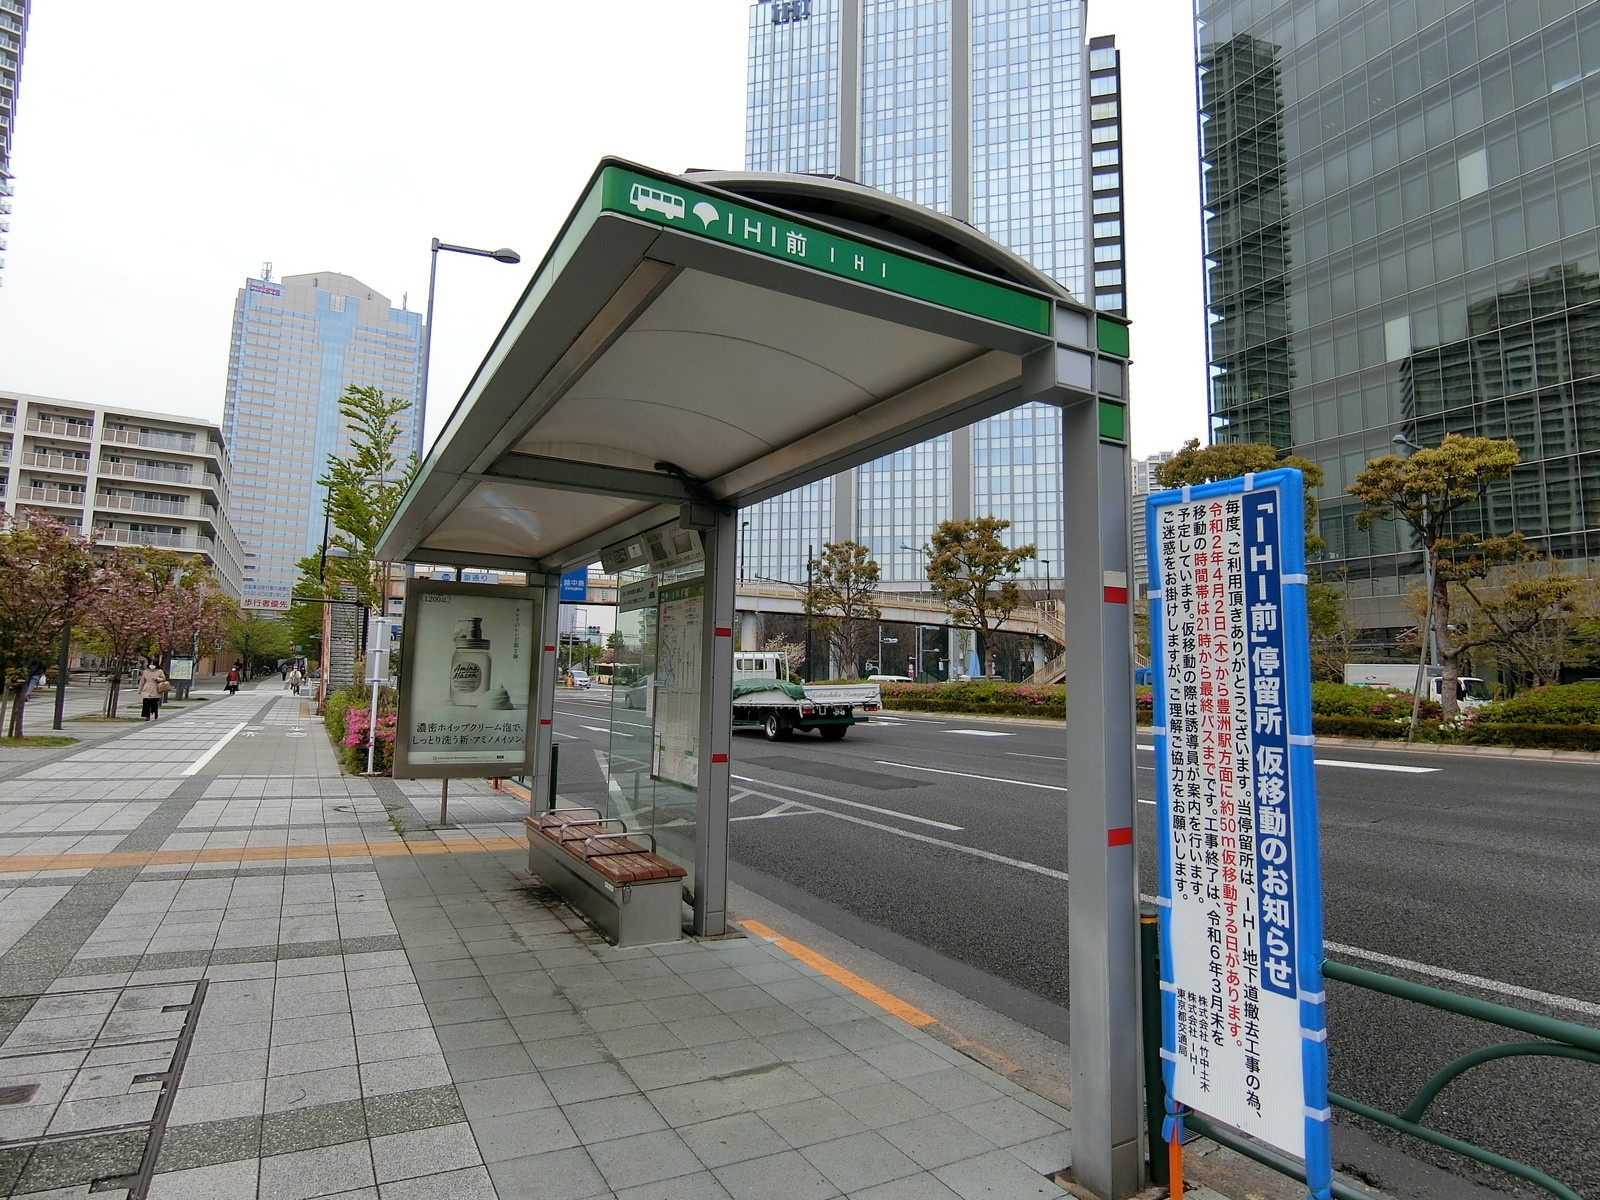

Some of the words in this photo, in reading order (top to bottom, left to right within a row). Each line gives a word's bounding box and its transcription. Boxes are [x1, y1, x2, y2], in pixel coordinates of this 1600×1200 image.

[727, 212, 807, 259] IHI前
[244, 598, 288, 608] 歩行者優先
[416, 722, 524, 733] 濃密ホイップクリーム泡で、
[1163, 511, 1188, 900] ご迷惑をお掛けしますが、ご理解ご協力をお願いします。
[1178, 508, 1204, 904] 予定しています。仮移動の際は誘導員が案内を行います。
[1256, 745, 1292, 989] 仮移動のお知らせ
[1177, 988, 1187, 1057] 東京都交通局
[1187, 991, 1198, 1039] 株式会社
[1198, 995, 1209, 1042] 株式会社
[1199, 1045, 1210, 1092] 竹中土木
